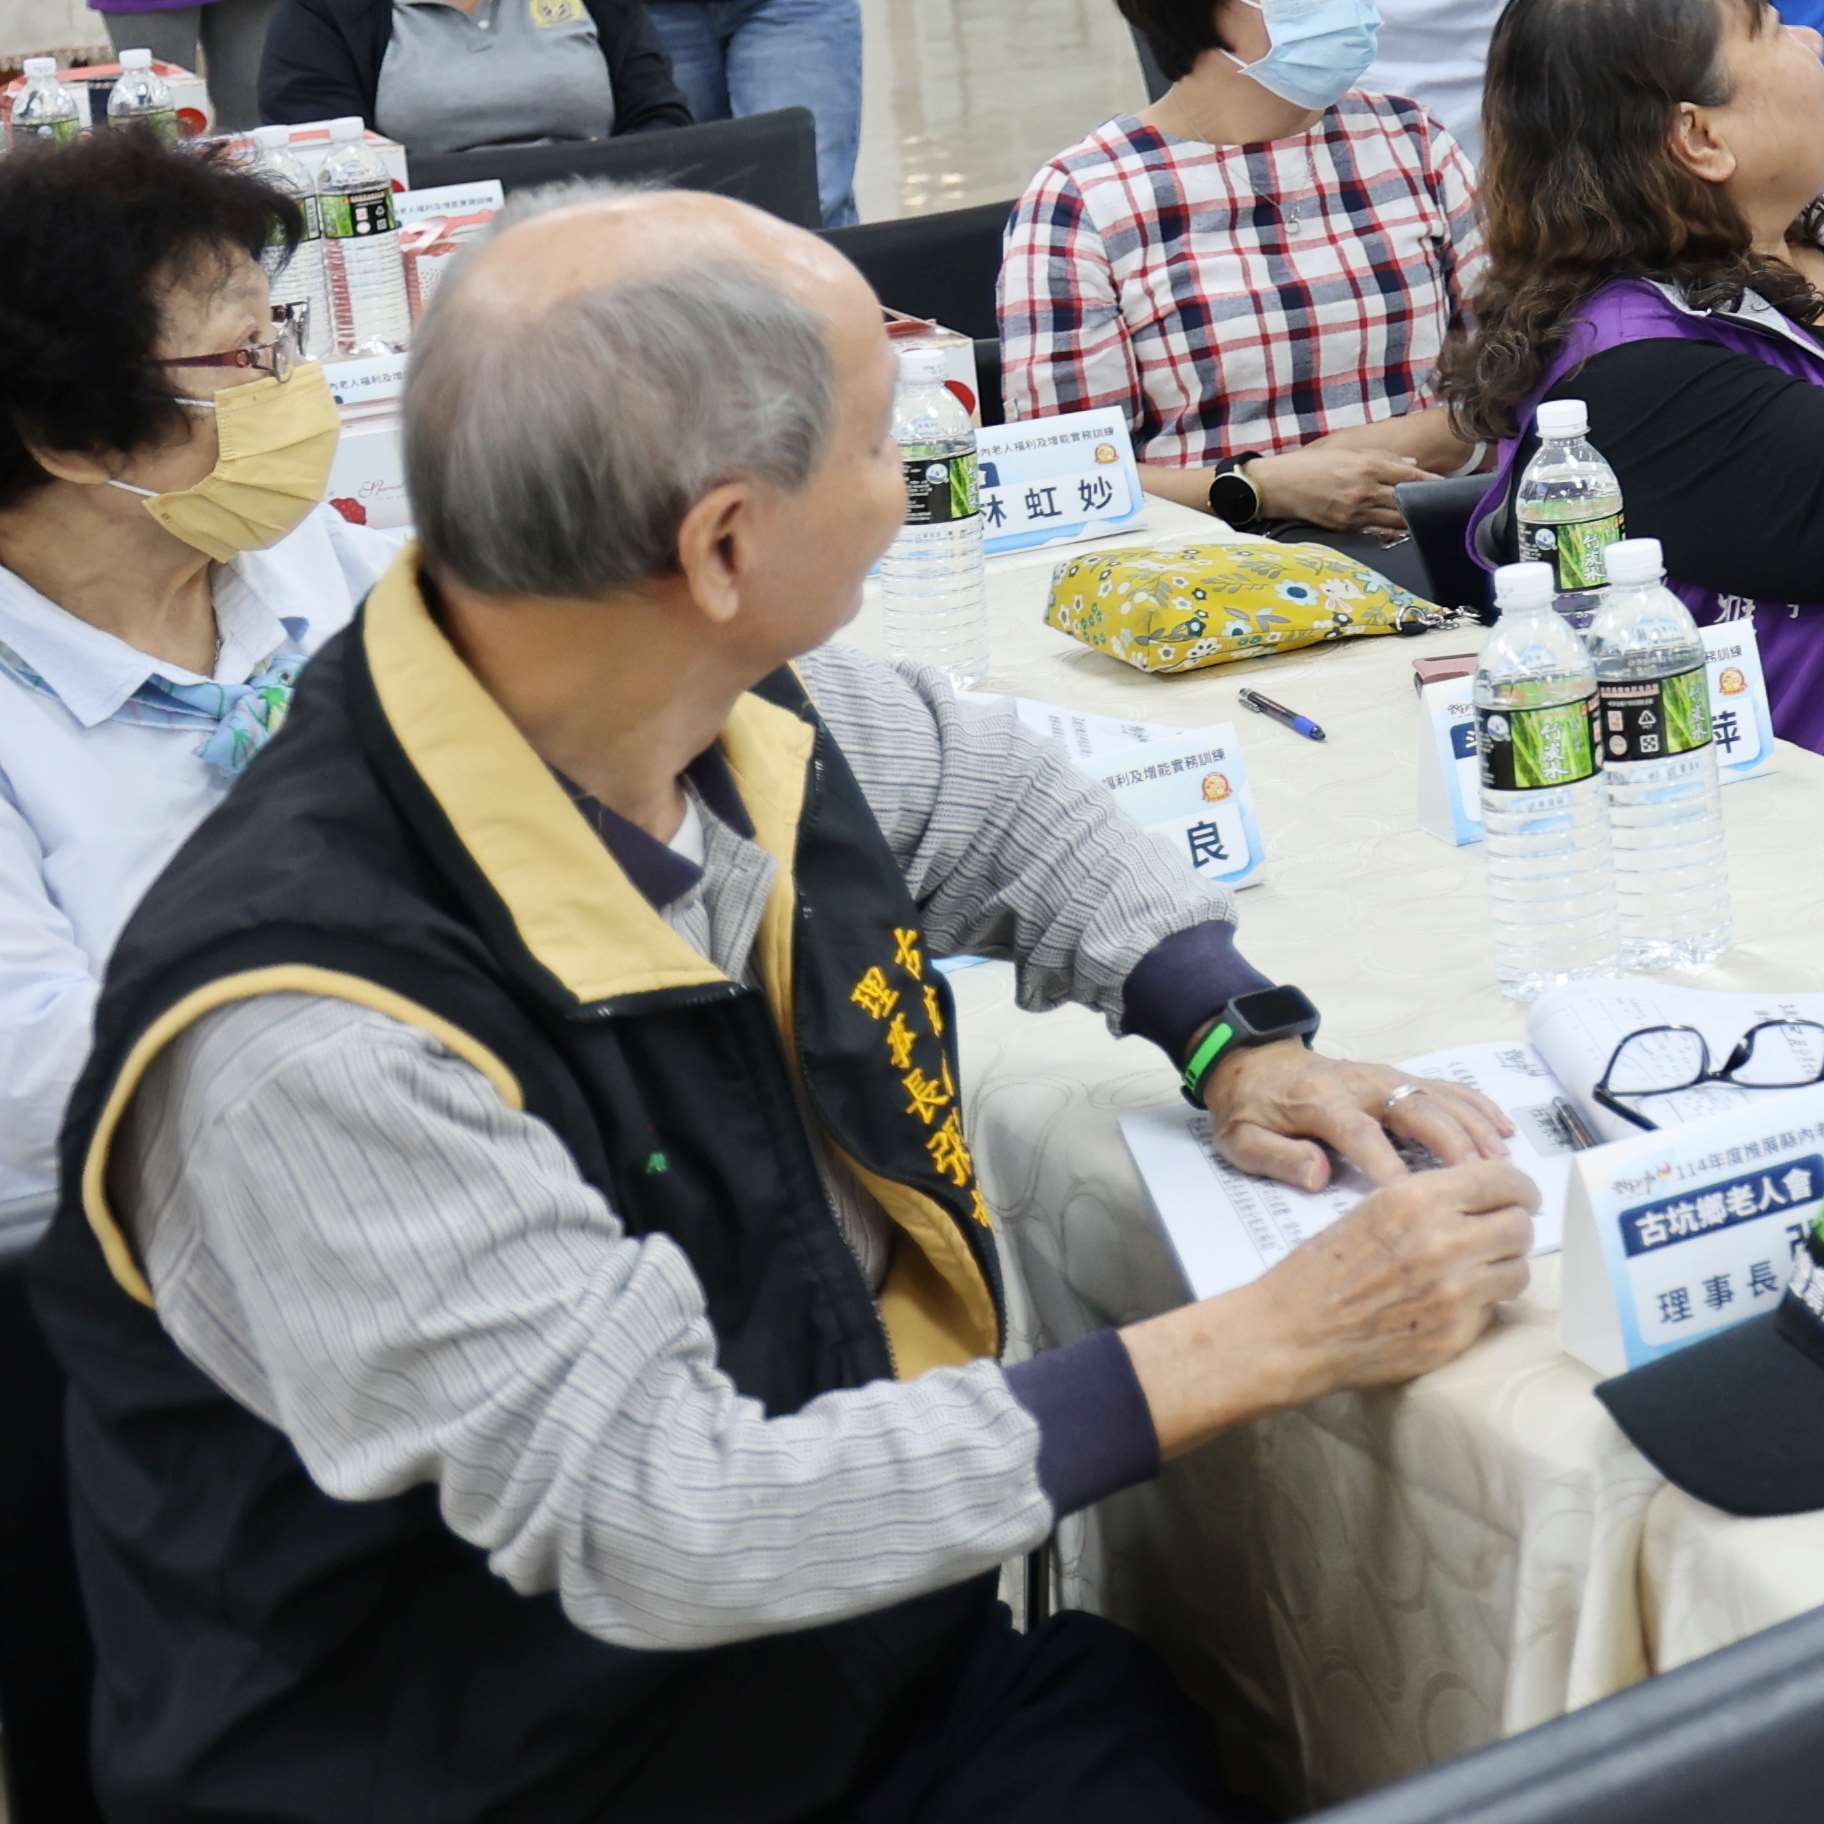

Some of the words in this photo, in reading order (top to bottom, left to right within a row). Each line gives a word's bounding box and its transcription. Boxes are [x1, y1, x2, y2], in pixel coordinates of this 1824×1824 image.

[1186, 820, 1229, 868] 良
[1635, 1168, 1813, 1249] 古坑鄉老人會
[1657, 1258, 1780, 1325] 理事長
